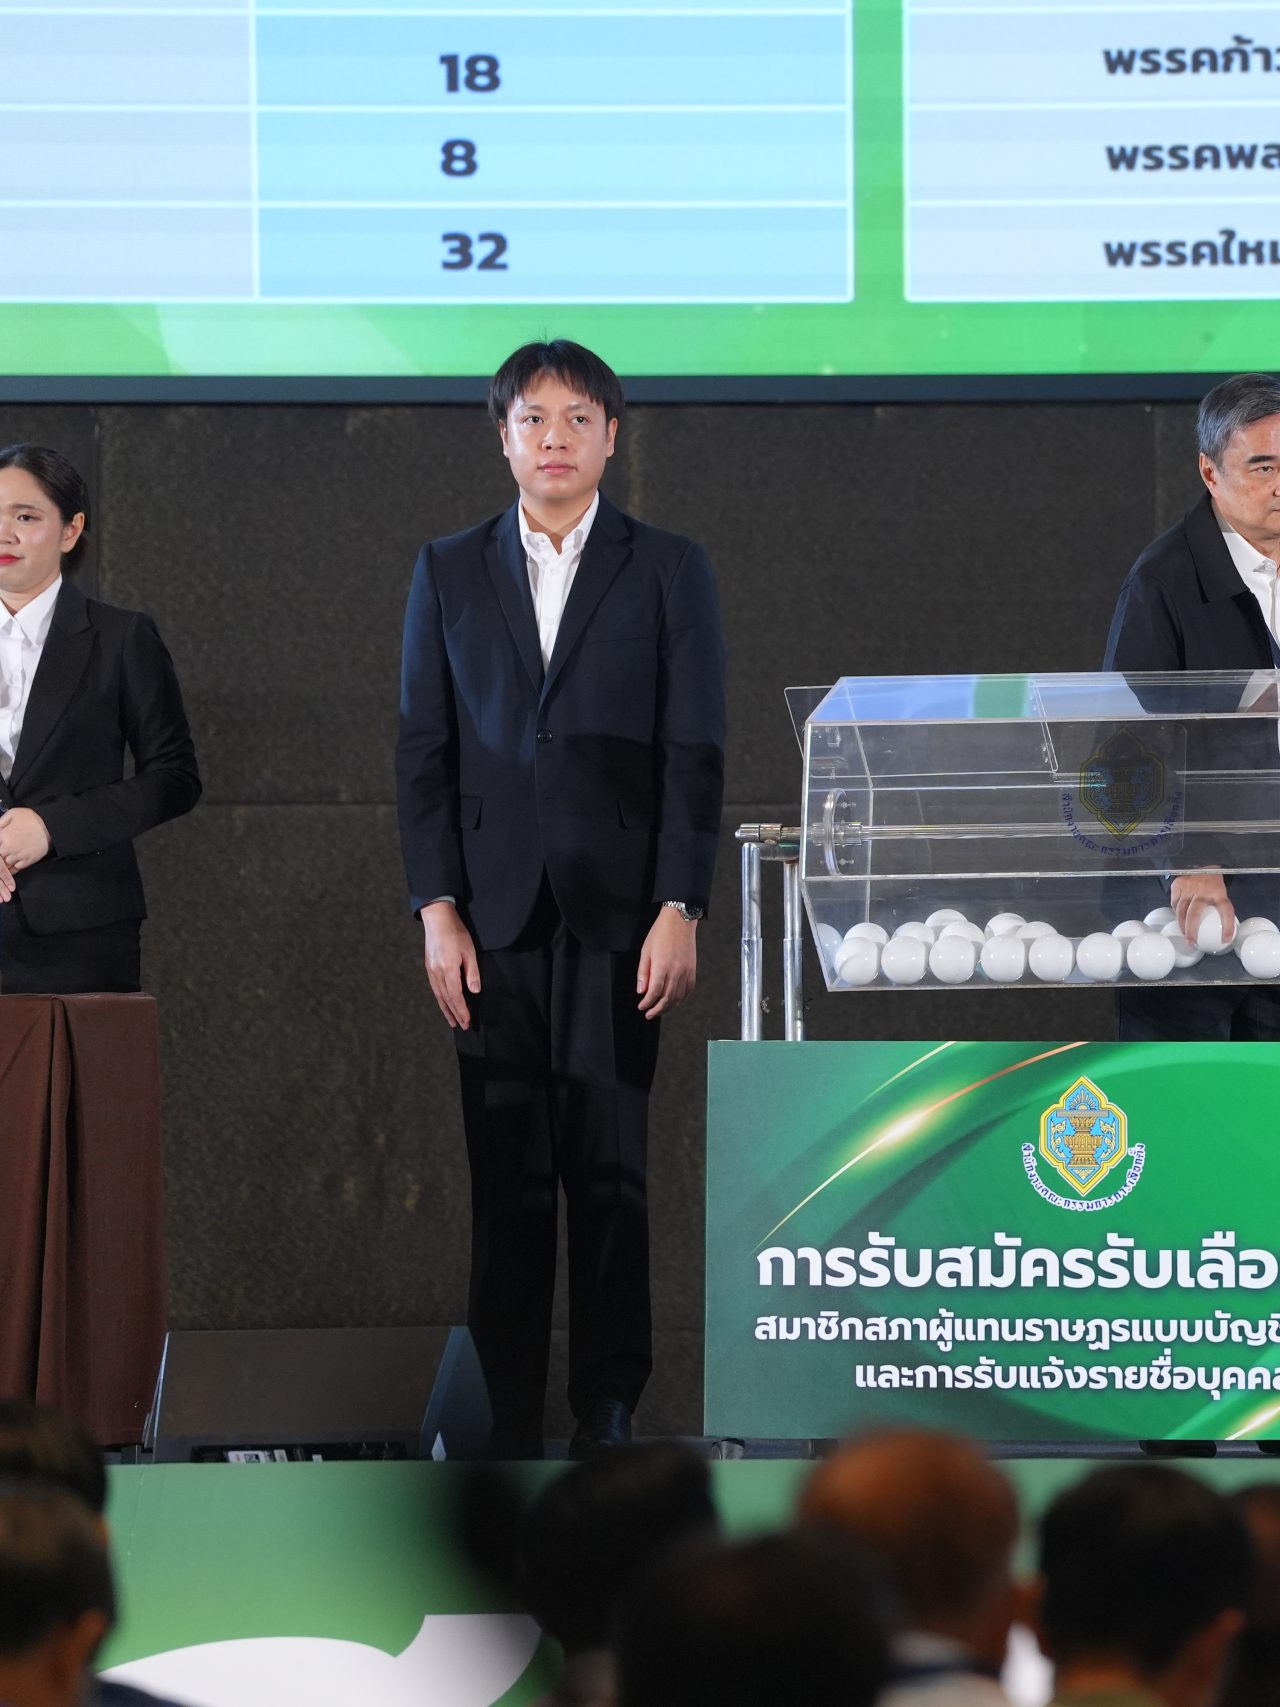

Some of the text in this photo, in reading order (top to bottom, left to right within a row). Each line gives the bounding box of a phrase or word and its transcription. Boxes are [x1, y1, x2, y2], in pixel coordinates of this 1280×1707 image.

[440, 54, 500, 92] 18
[441, 139, 478, 176] 8
[441, 232, 508, 270] 32
